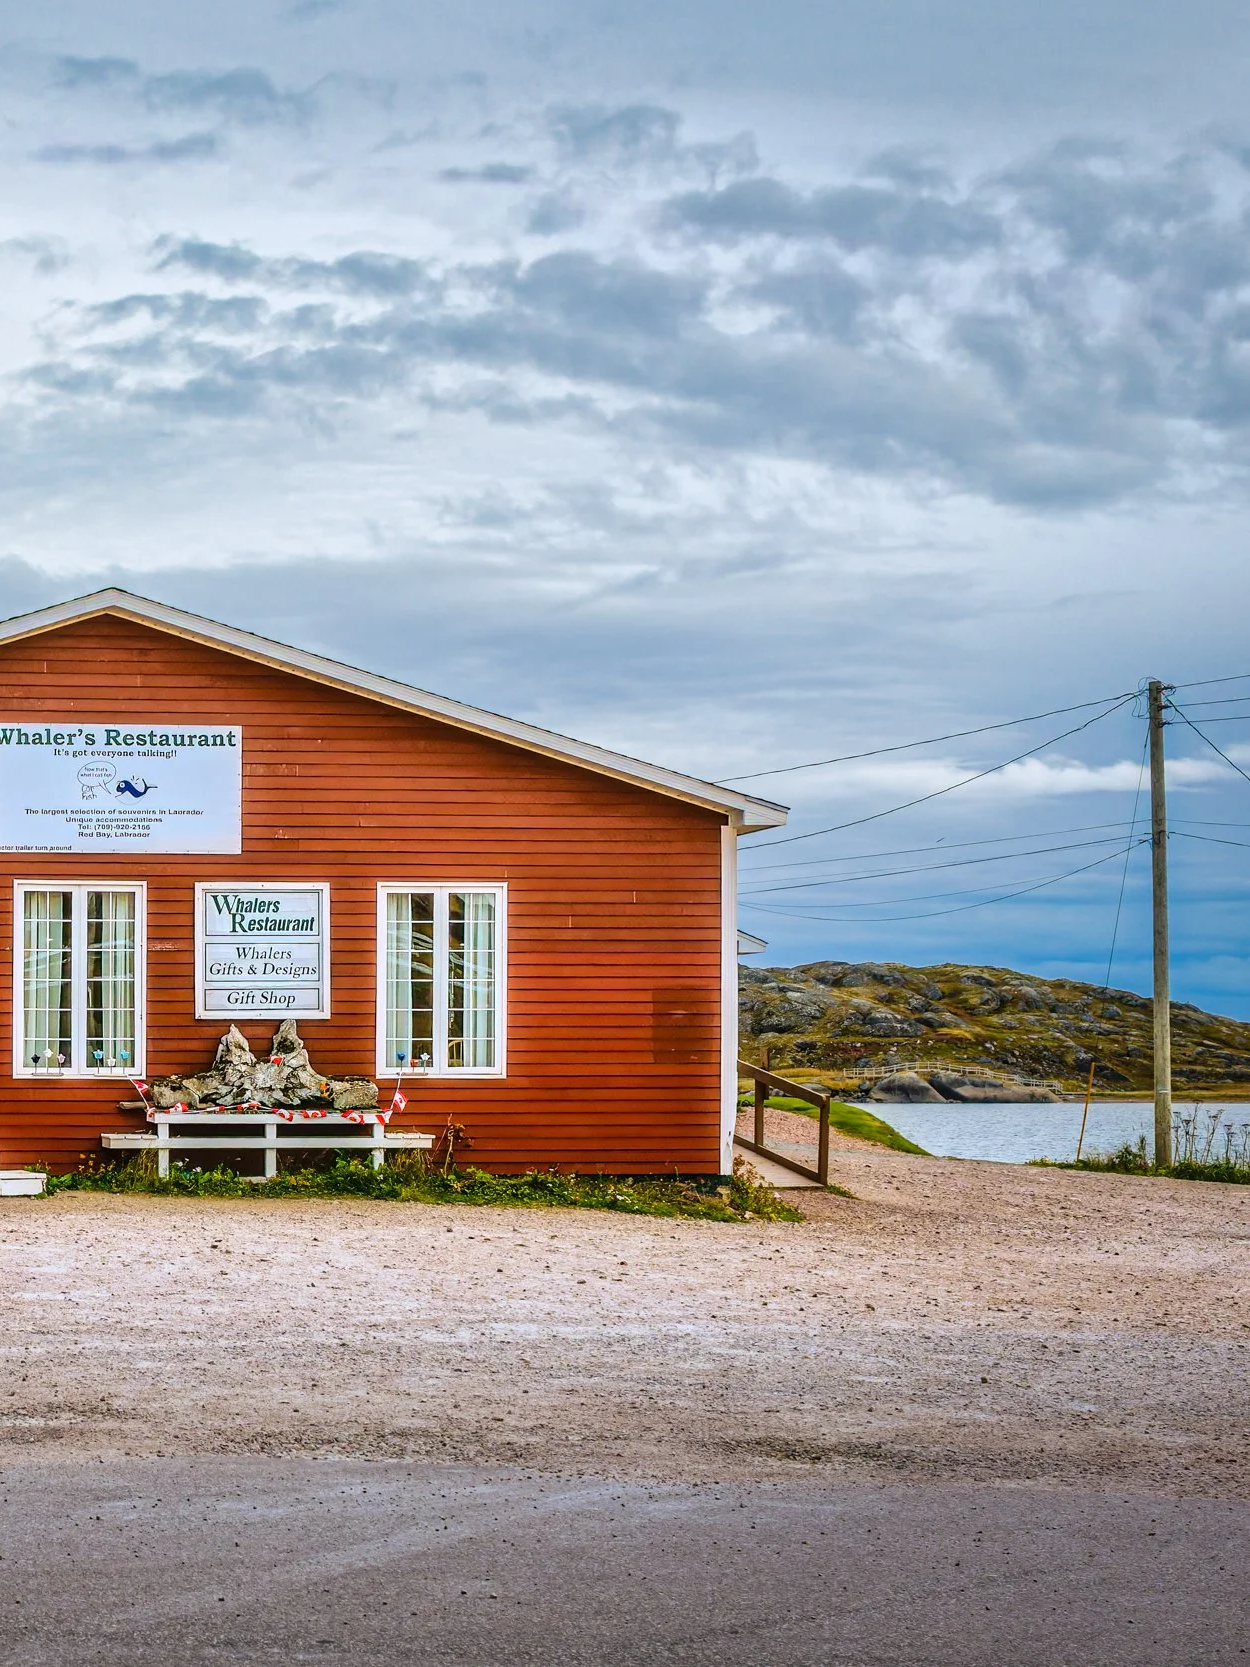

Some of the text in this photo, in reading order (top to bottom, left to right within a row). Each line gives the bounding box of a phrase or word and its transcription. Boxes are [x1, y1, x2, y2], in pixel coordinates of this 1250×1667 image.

[104, 729, 236, 747] Restaurant
[72, 750, 87, 758] got
[90, 750, 134, 758] everyone
[137, 750, 177, 759] talking!!
[41, 808, 68, 816] largest
[211, 894, 281, 916] Whalers
[230, 913, 315, 933] Restaurant
[236, 946, 292, 960] Whalers
[209, 963, 317, 978] Gifts & Designs
[227, 991, 296, 1007] Gift Shop
